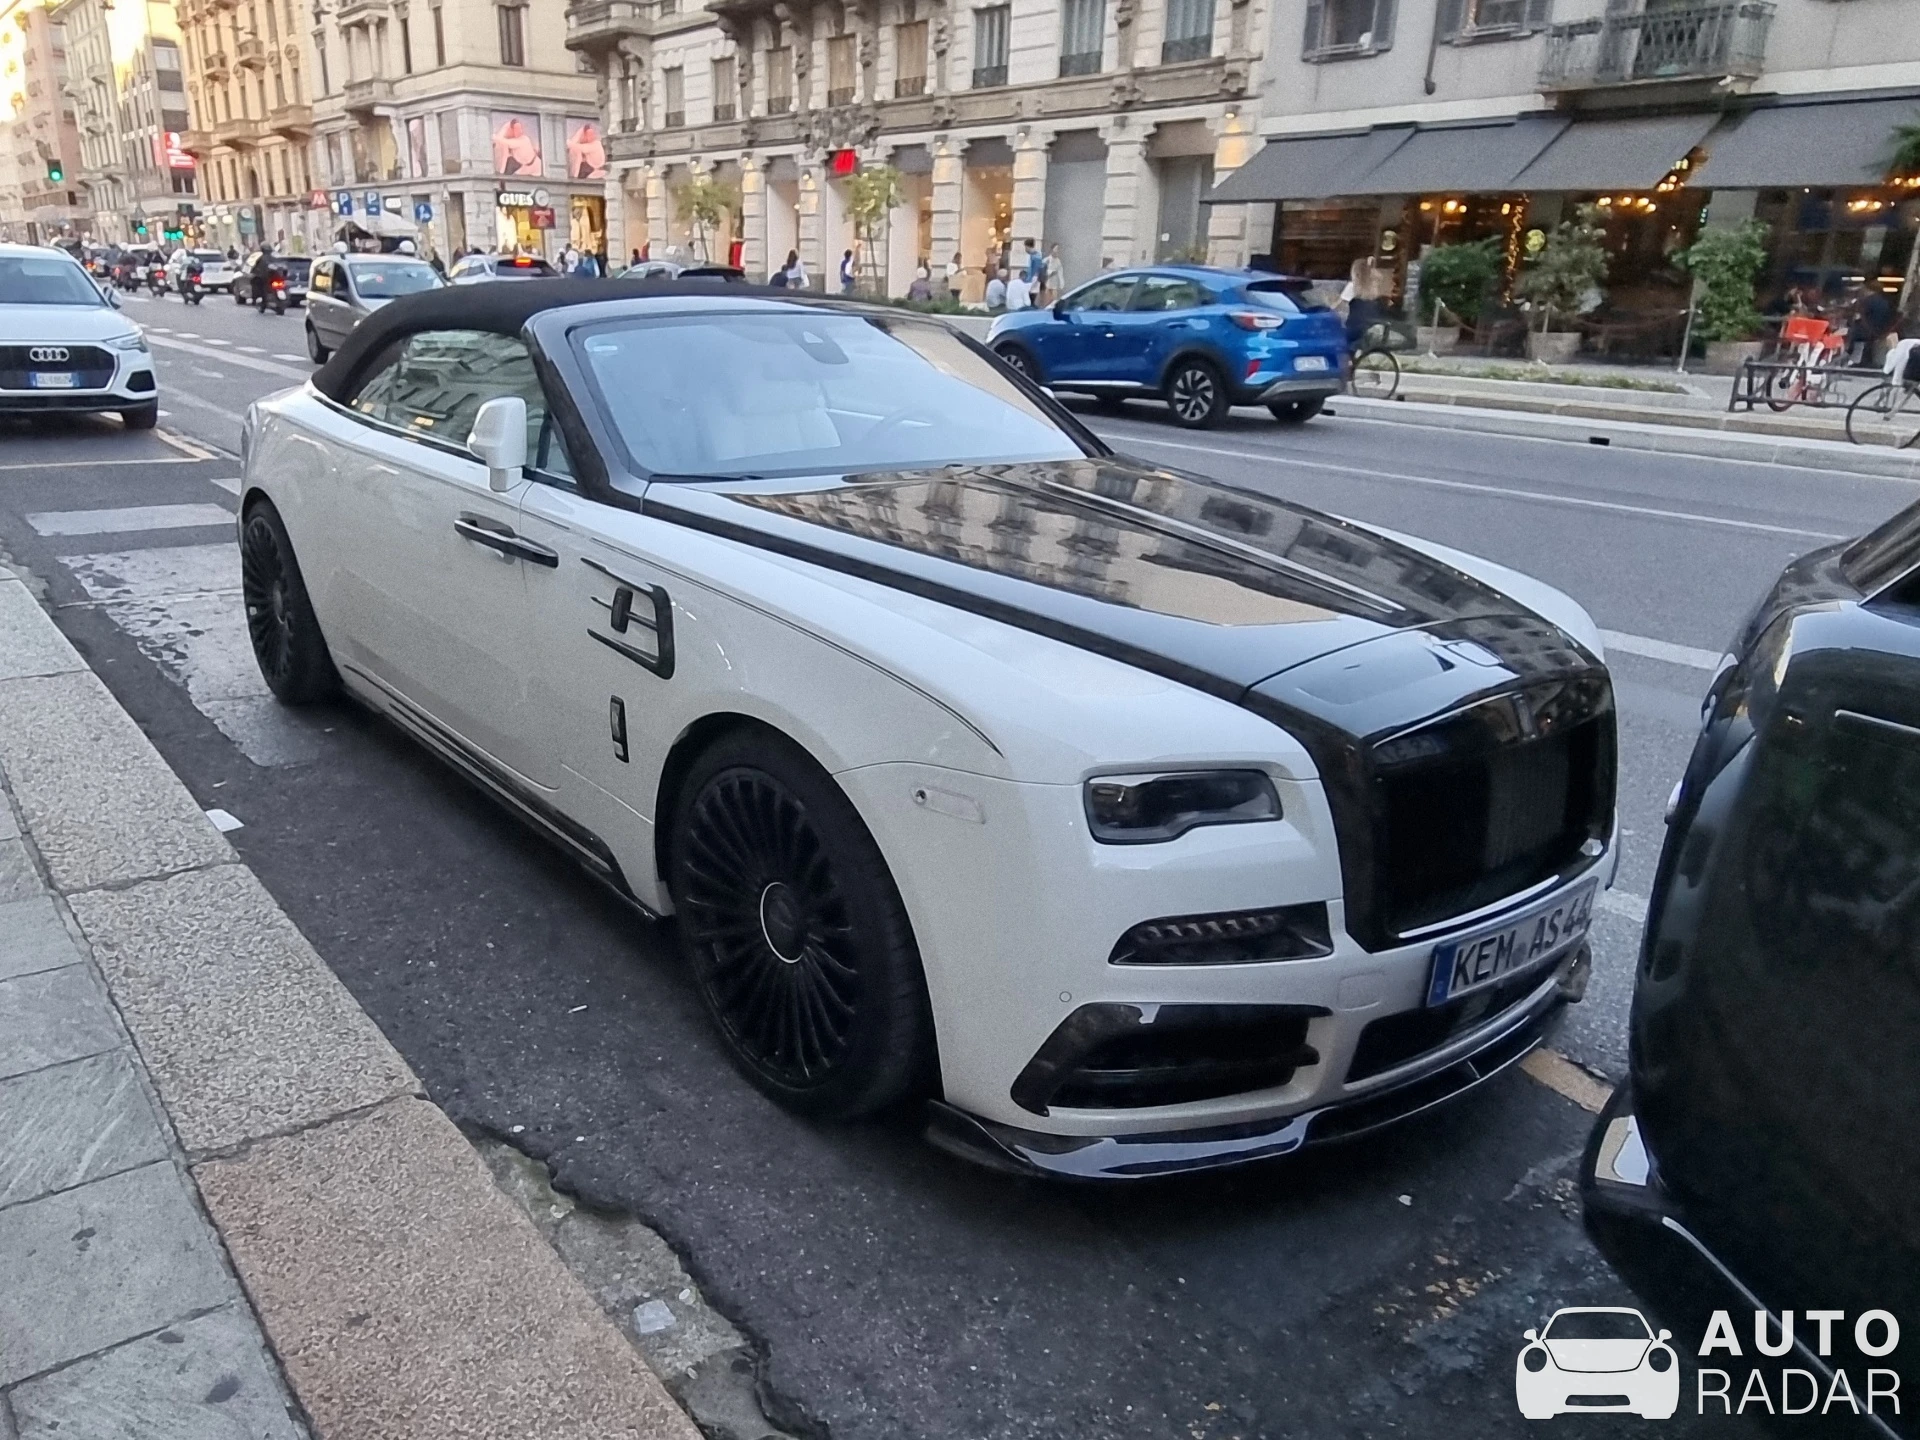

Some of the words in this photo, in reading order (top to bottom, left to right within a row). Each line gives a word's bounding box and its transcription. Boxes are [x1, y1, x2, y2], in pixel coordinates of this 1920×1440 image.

[340, 192, 349, 204] P
[367, 192, 377, 204] P
[500, 193, 534, 206] GUES
[1451, 930, 1516, 990] KEM
